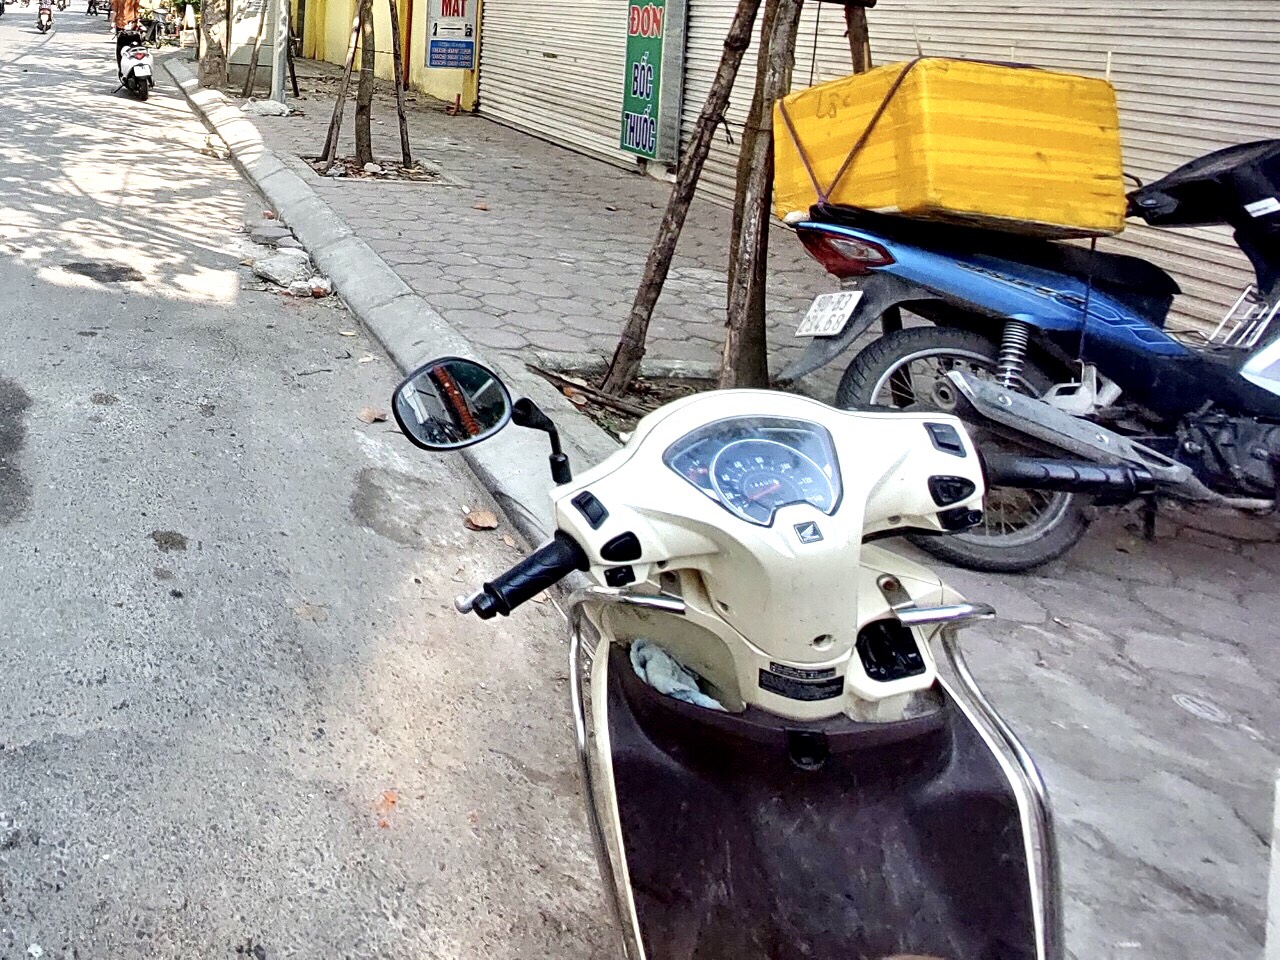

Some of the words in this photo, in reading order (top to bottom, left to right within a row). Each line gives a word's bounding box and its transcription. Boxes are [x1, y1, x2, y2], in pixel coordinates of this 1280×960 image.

[628, 2, 664, 39] ĐƠN
[631, 51, 654, 100] BỐC
[623, 103, 657, 155] THUỐC
